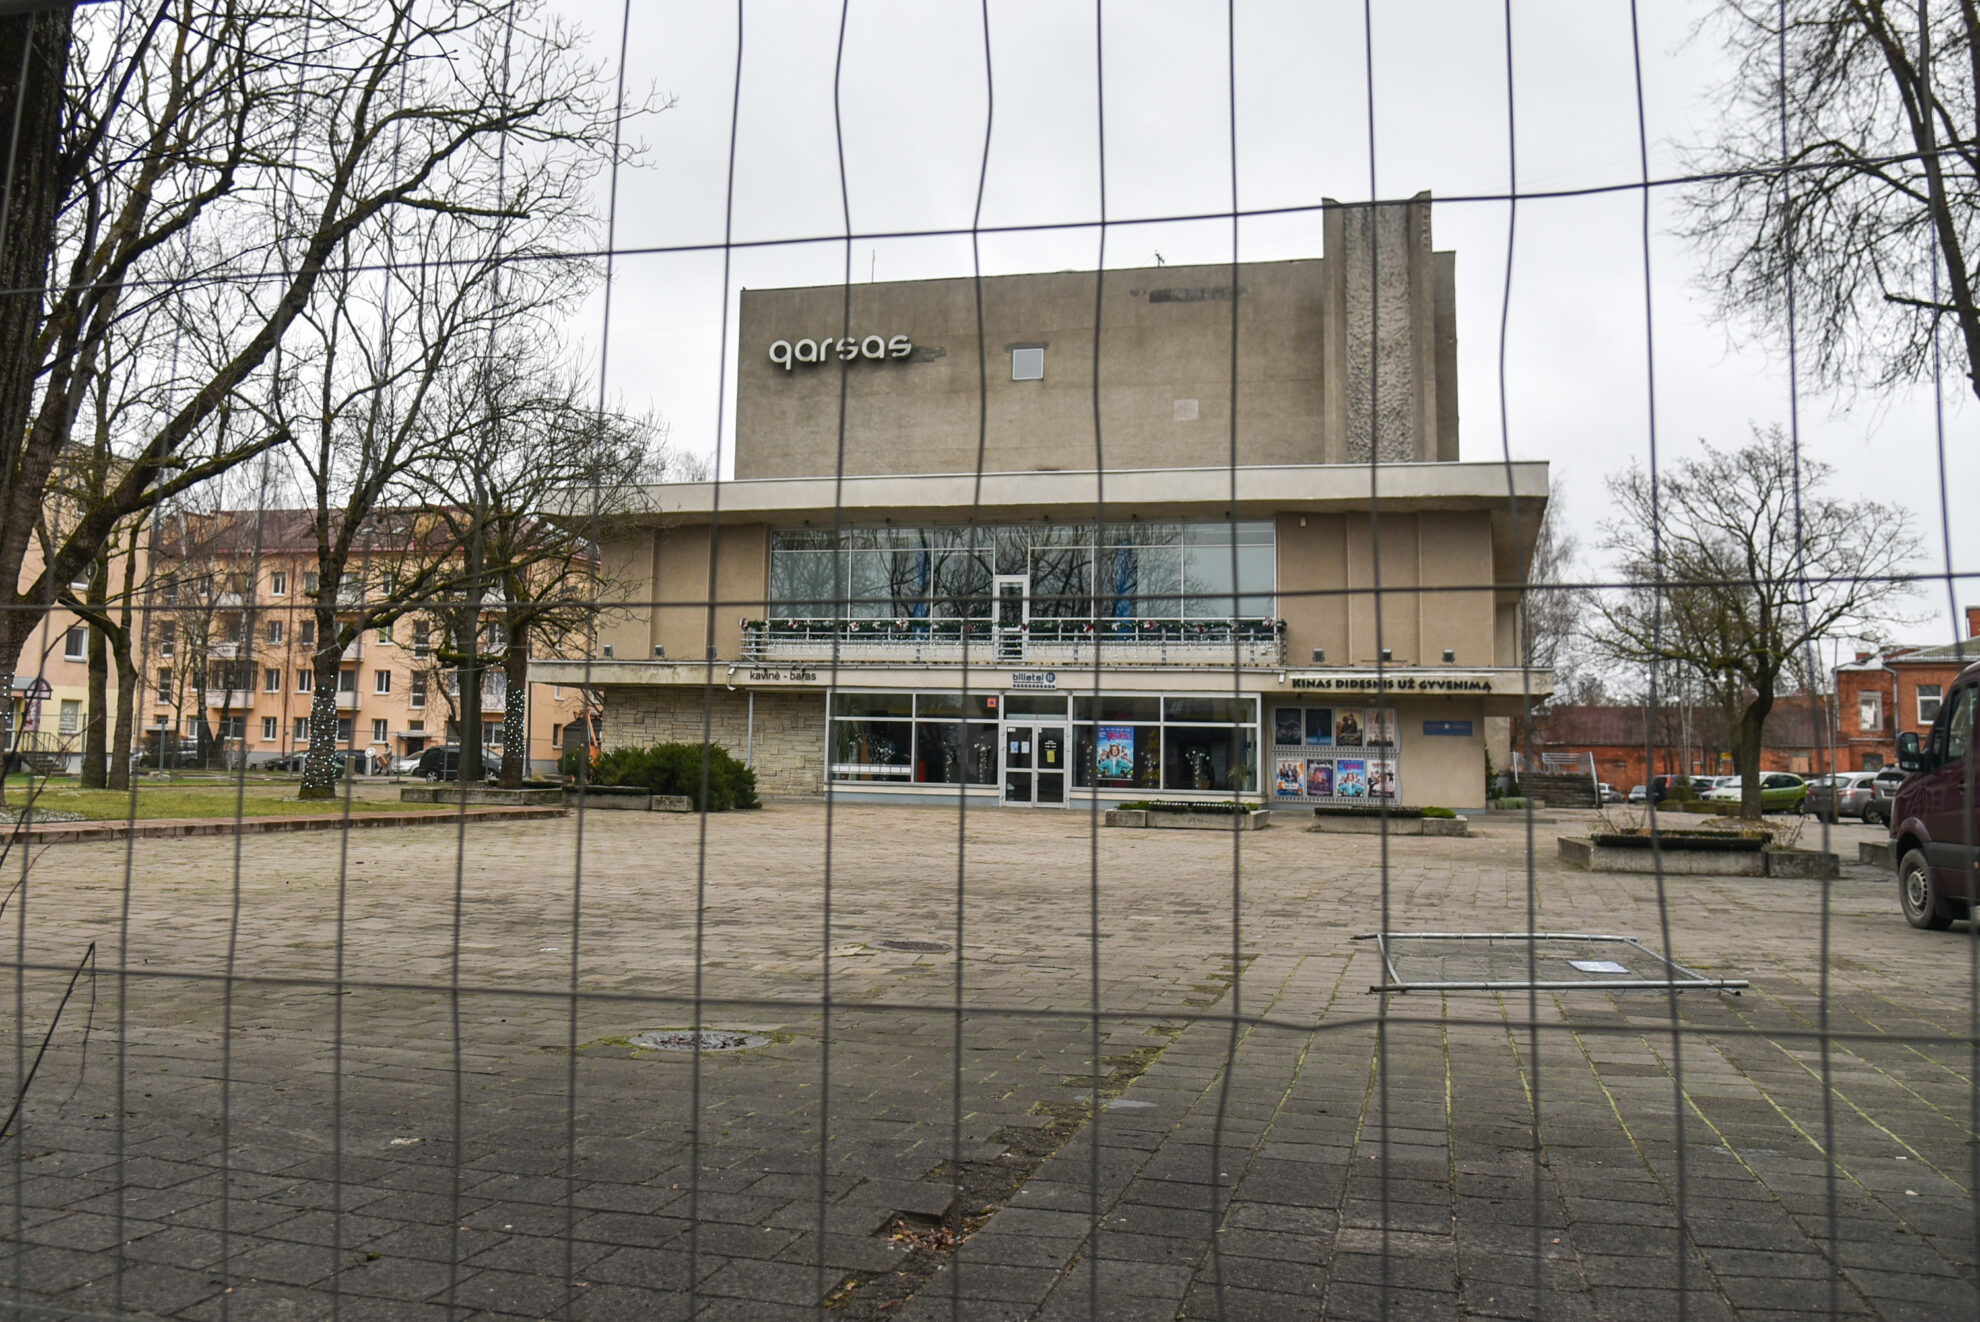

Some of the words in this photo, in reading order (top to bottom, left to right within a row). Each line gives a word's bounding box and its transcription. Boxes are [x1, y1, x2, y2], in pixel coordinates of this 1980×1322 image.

[750, 671, 780, 680] kavinė
[790, 671, 816, 680] baras
[1292, 678, 1332, 689] KINAS
[1335, 679, 1394, 689] DIDESNIS
[1397, 677, 1415, 689] UŽ
[1419, 680, 1492, 692] GYVENIMĄ
